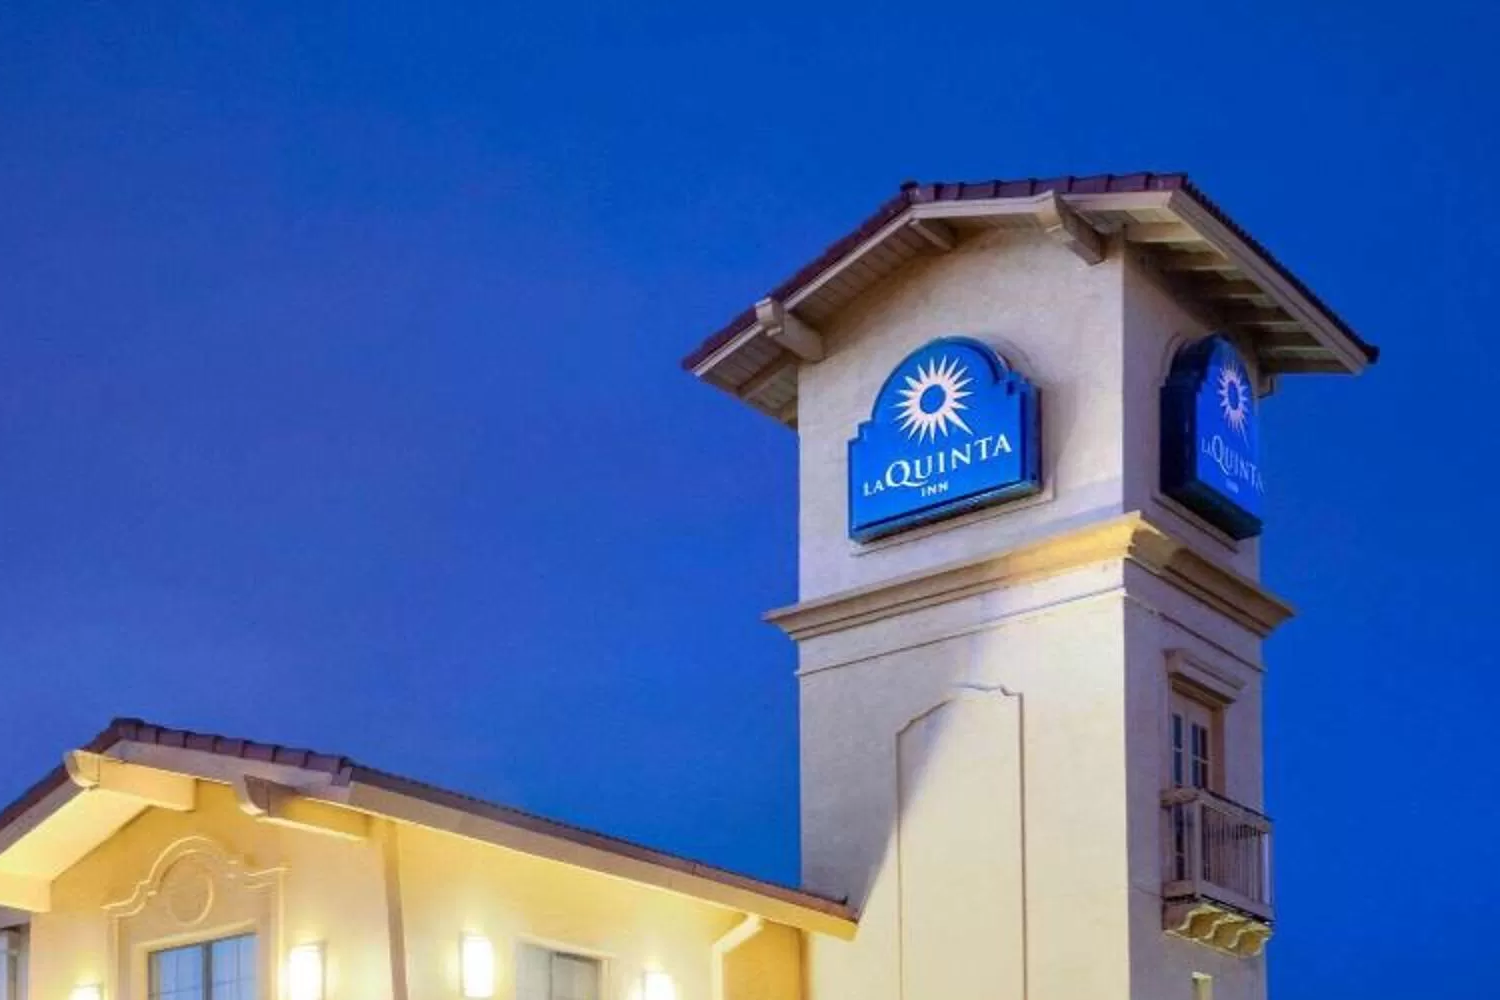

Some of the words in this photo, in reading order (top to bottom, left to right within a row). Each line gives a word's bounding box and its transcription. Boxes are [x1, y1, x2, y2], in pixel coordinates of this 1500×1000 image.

[863, 479, 883, 496] LA
[885, 433, 1012, 487] QUINTA
[921, 482, 949, 497] INN
[1212, 435, 1265, 496] QUINTA
